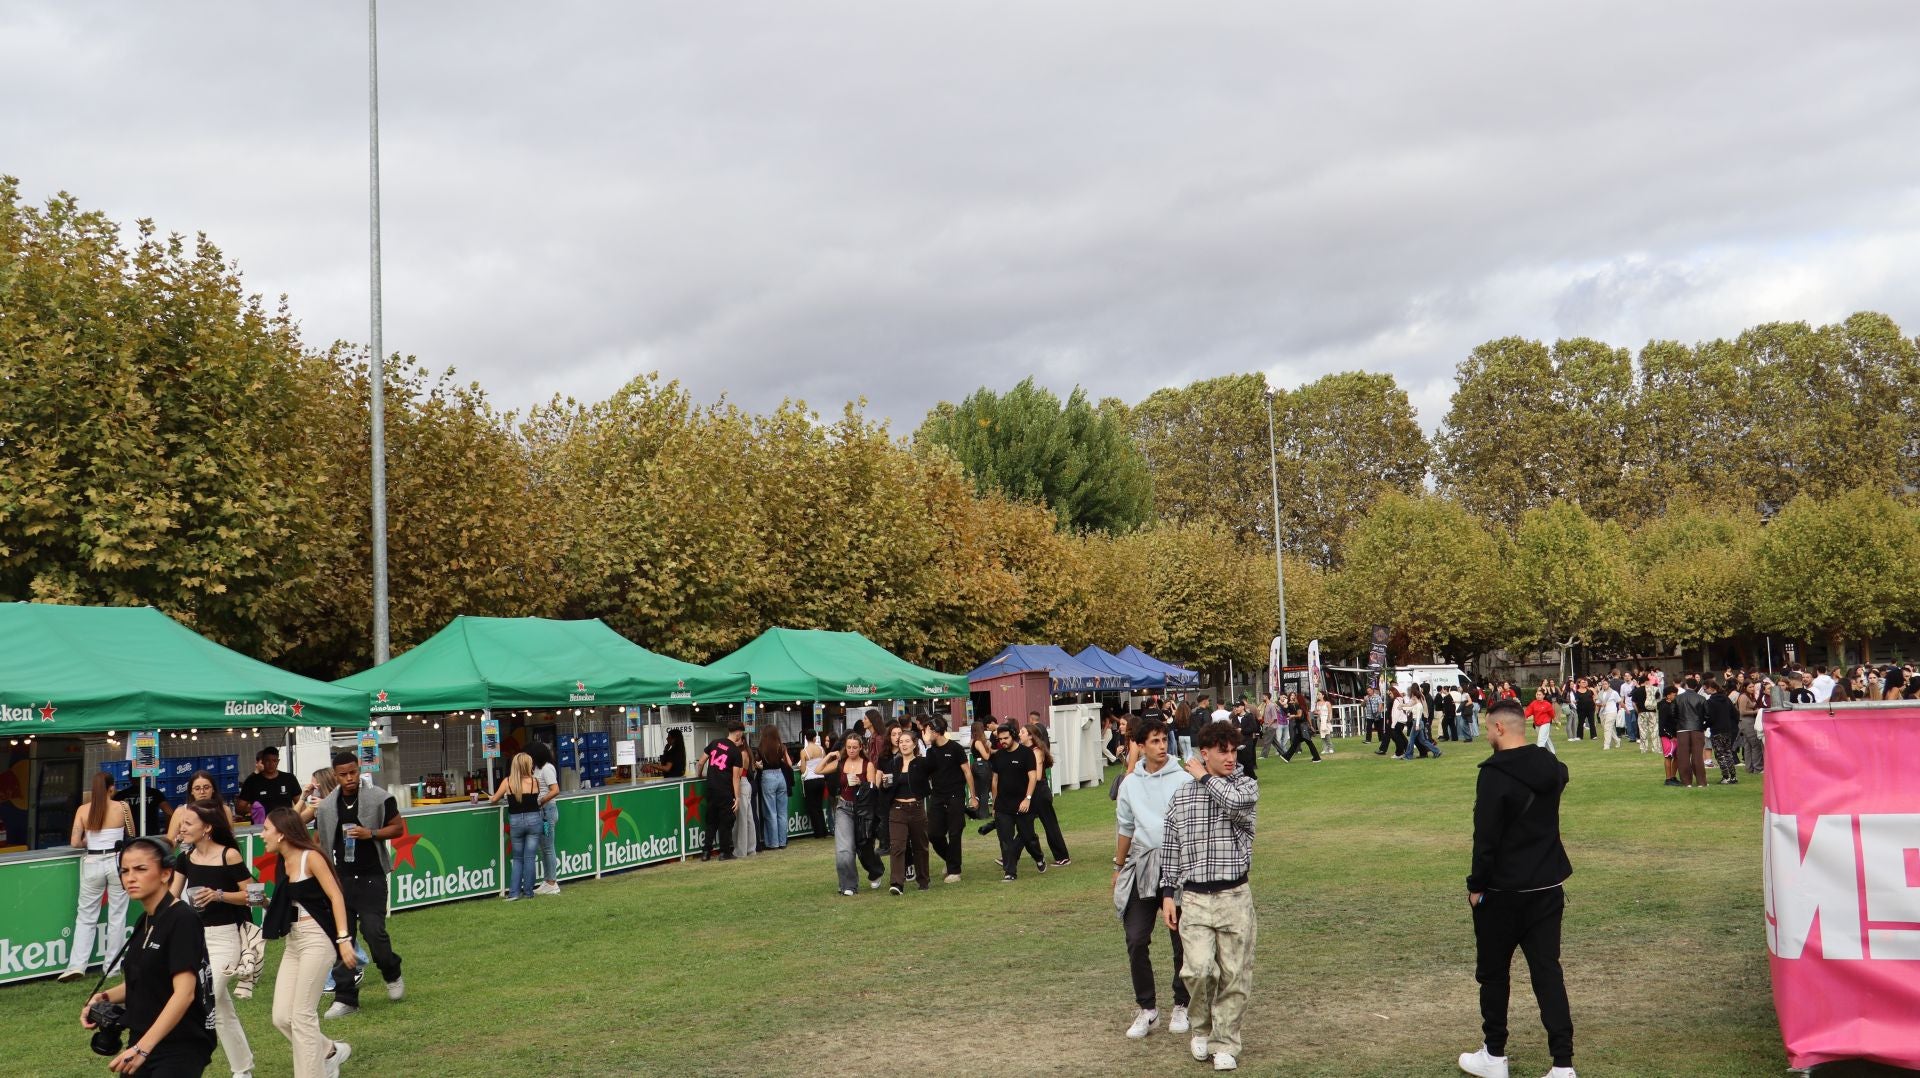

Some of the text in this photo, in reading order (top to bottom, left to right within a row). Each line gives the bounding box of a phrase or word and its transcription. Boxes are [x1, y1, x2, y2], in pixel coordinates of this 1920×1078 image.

[224, 700, 287, 716] Heineken
[710, 750, 728, 770] 14
[605, 835, 678, 867] Heineken
[397, 865, 495, 903] Heineken
